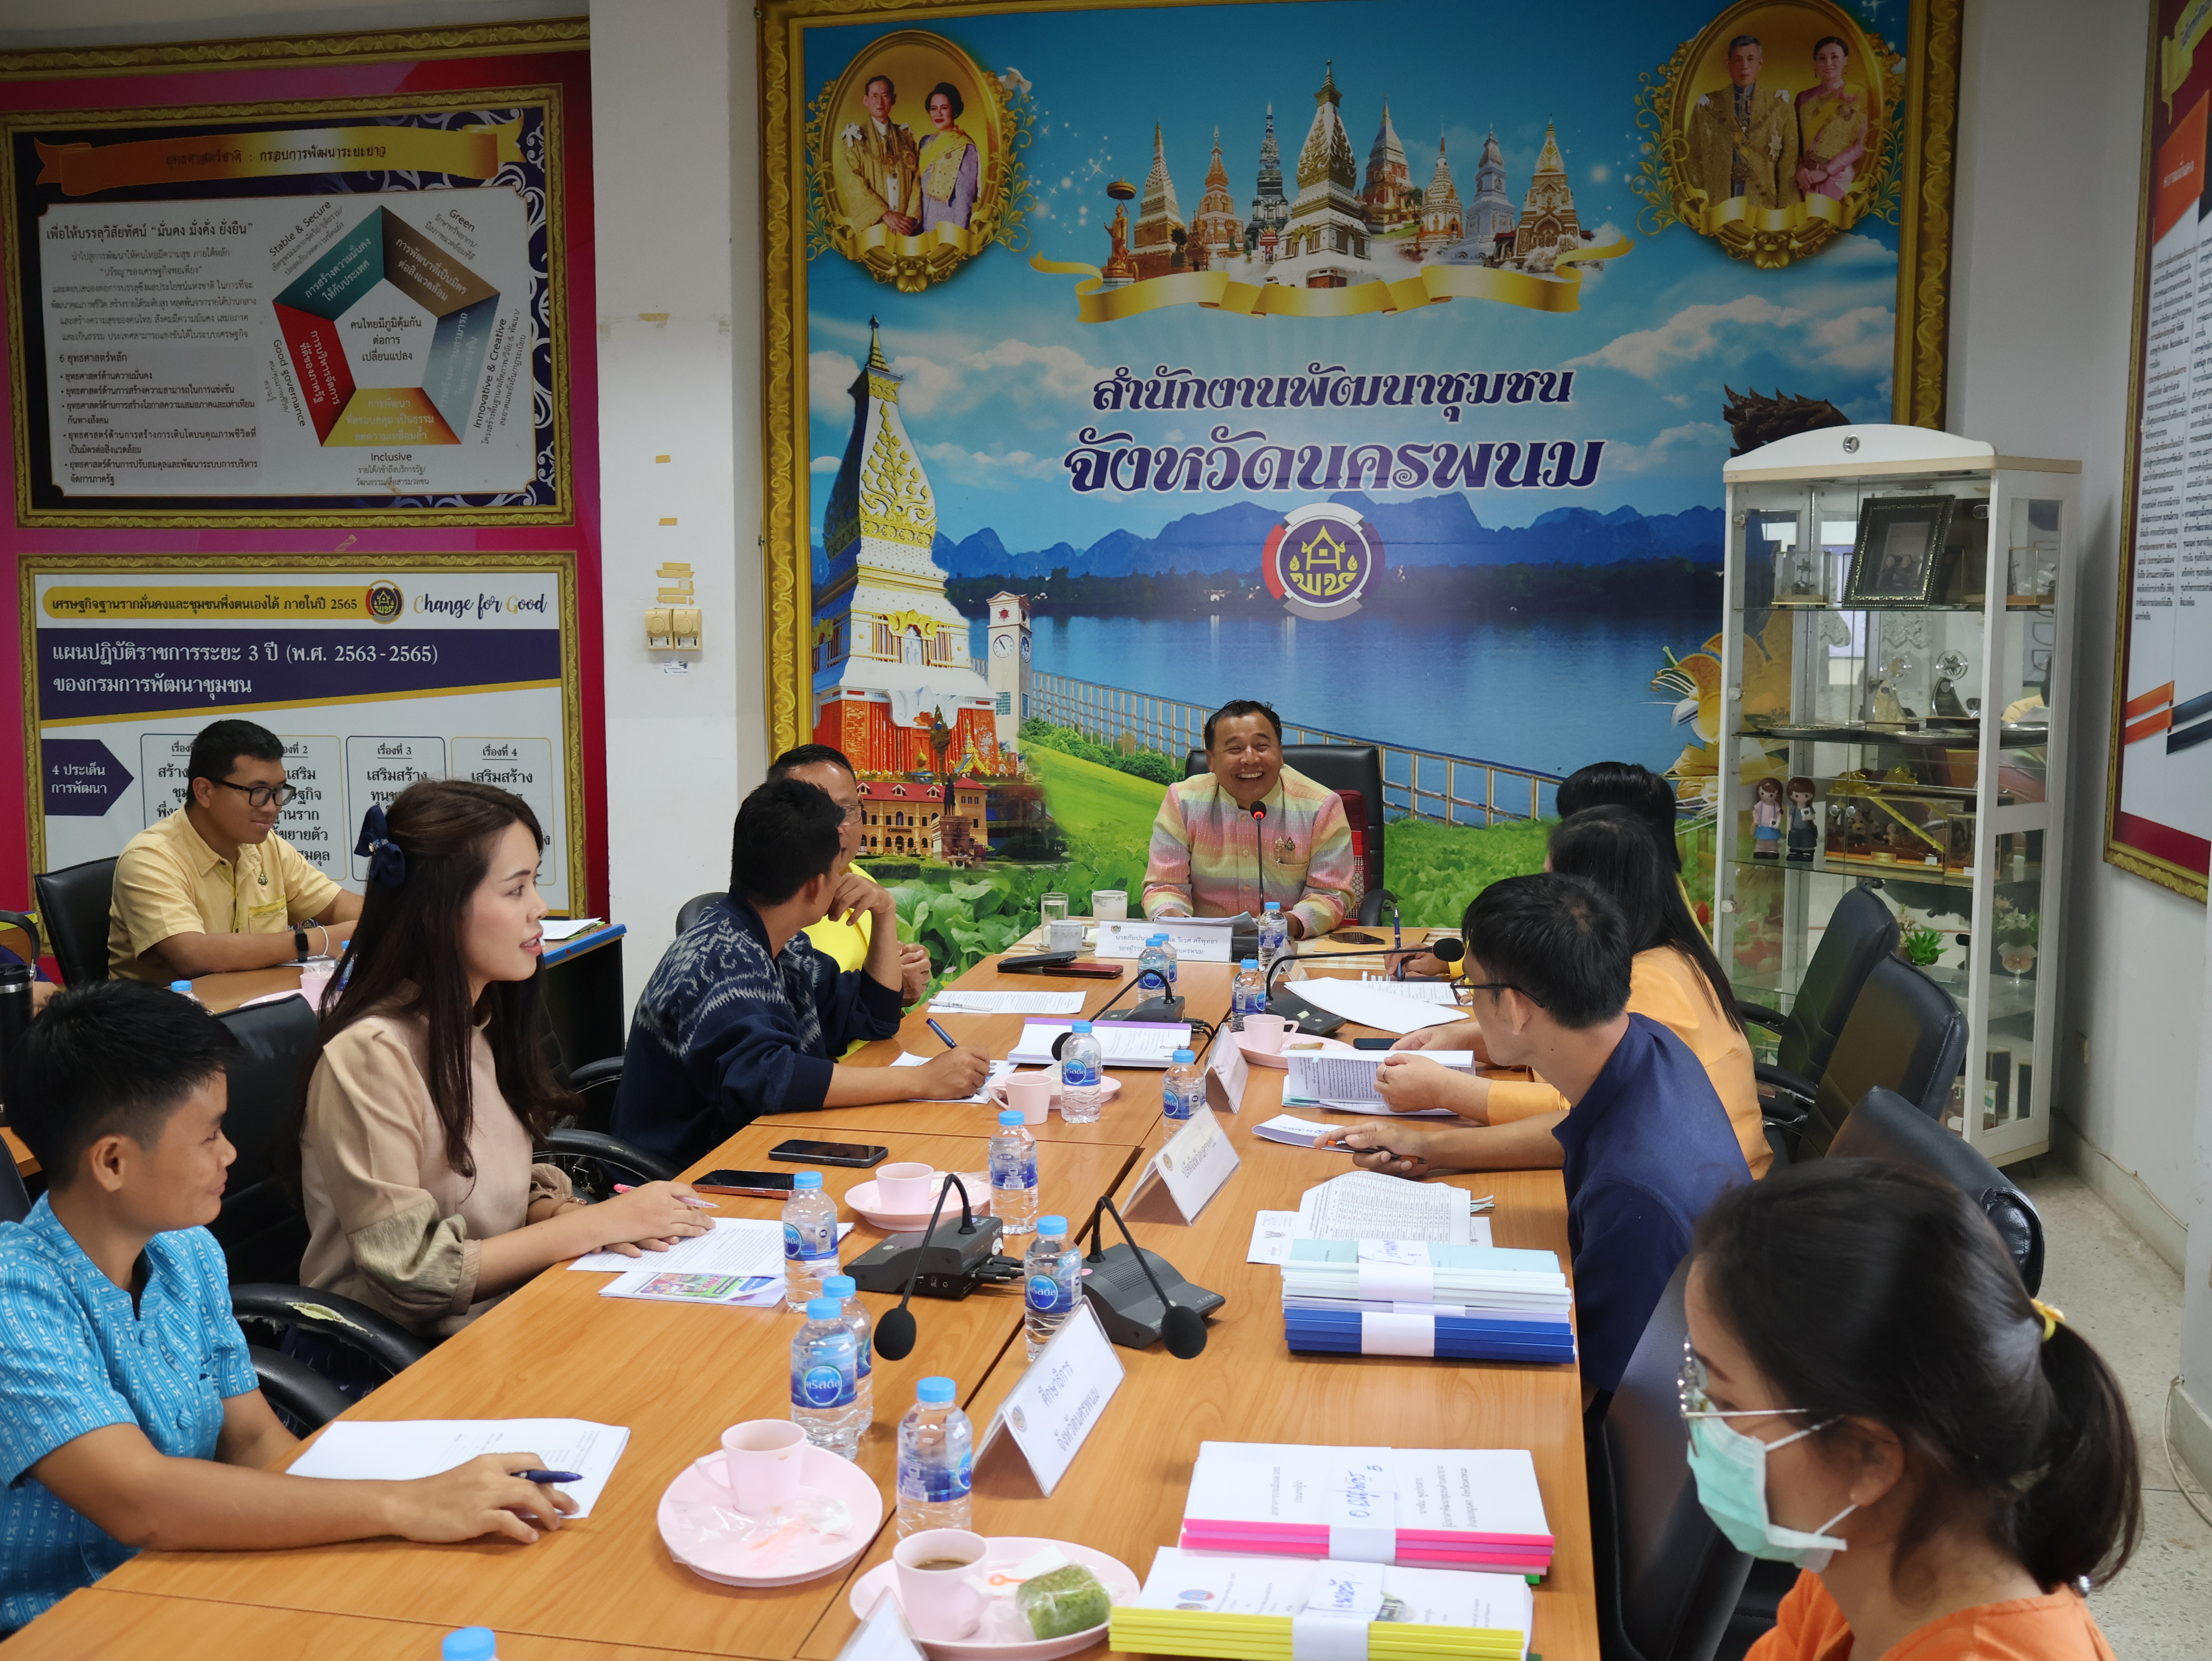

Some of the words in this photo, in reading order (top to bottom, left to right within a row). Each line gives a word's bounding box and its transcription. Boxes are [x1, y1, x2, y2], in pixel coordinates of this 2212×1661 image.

[47, 223, 146, 242] เพื่อให้บรรลุวิสัยทัศน์
[190, 219, 215, 236] มั่งคั่ง
[269, 232, 295, 257] Stable
[296, 225, 304, 235] &
[303, 201, 332, 227] Secure
[449, 209, 475, 232] Green
[305, 238, 372, 299] การสร้างความมั่นคง
[322, 259, 370, 301] ให้กับประเทศ
[398, 259, 448, 302] ต่อสิ่งแวดล้อม
[350, 316, 421, 332] คนไทยมีภูมิคุ้มกัน
[373, 335, 400, 345] ต่อการ
[68, 352, 127, 365] ยุทธศาสตร์หลัก
[311, 330, 340, 405] การบริหารจัดการ
[362, 351, 412, 362] เปลี่ยนแปลง
[65, 368, 152, 382] ยุทธศาสตร์ด้านความมั่นคง
[273, 339, 288, 366] Good
[281, 369, 306, 427] governance
[299, 342, 324, 404] ที่ดีของภาครัฐ
[474, 374, 493, 428] Innovative
[490, 318, 507, 361] Creative
[1094, 363, 1574, 423] สำนักงานพัฒนาชุมชน
[371, 452, 412, 461] Inclusive
[1064, 426, 1605, 492] จังหวัดนครพนม
[71, 474, 114, 486] จัดการภาครัฐ
[53, 595, 279, 614] เศรษฐกิจฐานรากมั่นคงและชุมชนพึ่งตนเองได้
[284, 595, 325, 610] ภายในปี
[331, 599, 357, 610] 2565
[414, 593, 473, 617] Change
[478, 593, 502, 619] for
[506, 593, 547, 614] Good
[53, 640, 241, 665] แผนปฏิบัติราชการระยะ
[249, 645, 258, 661] 3
[264, 642, 278, 661] ปี
[286, 645, 327, 665] (พ.ศ.
[53, 673, 252, 701] ของกรมการพัฒนาชุมชน
[303, 746, 308, 754] 2
[377, 742, 403, 755] เรื่องที่
[406, 746, 411, 755] 3
[482, 746, 507, 757] เรื่องที่
[52, 764, 59, 775] 4
[64, 762, 105, 776] ประเด็น
[367, 767, 427, 781] เสริมสร้าง
[472, 770, 533, 784] เสริมสร้าง
[51, 781, 107, 794] การพัฒนา
[1038, 1360, 1074, 1407] ศึกษาธิการ
[1054, 1386, 1100, 1451] จังหวัดนครพนม
